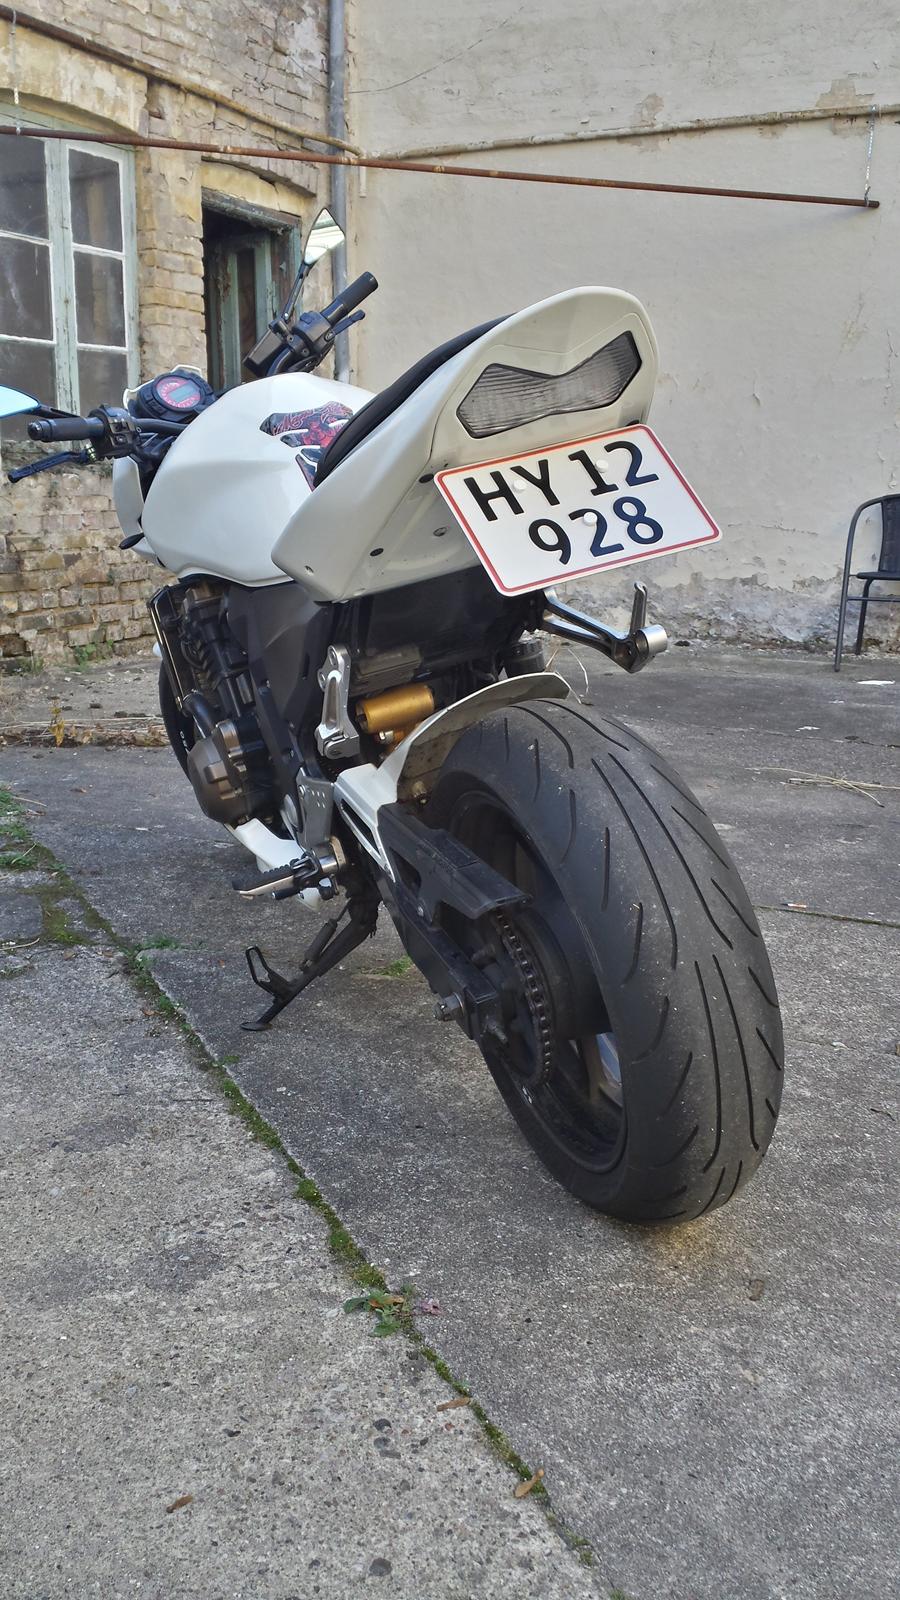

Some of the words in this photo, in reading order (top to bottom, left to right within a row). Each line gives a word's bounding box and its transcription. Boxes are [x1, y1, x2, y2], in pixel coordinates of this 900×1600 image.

[463, 459, 560, 522] HY
[568, 440, 660, 496] 12
[528, 496, 664, 565] 928
